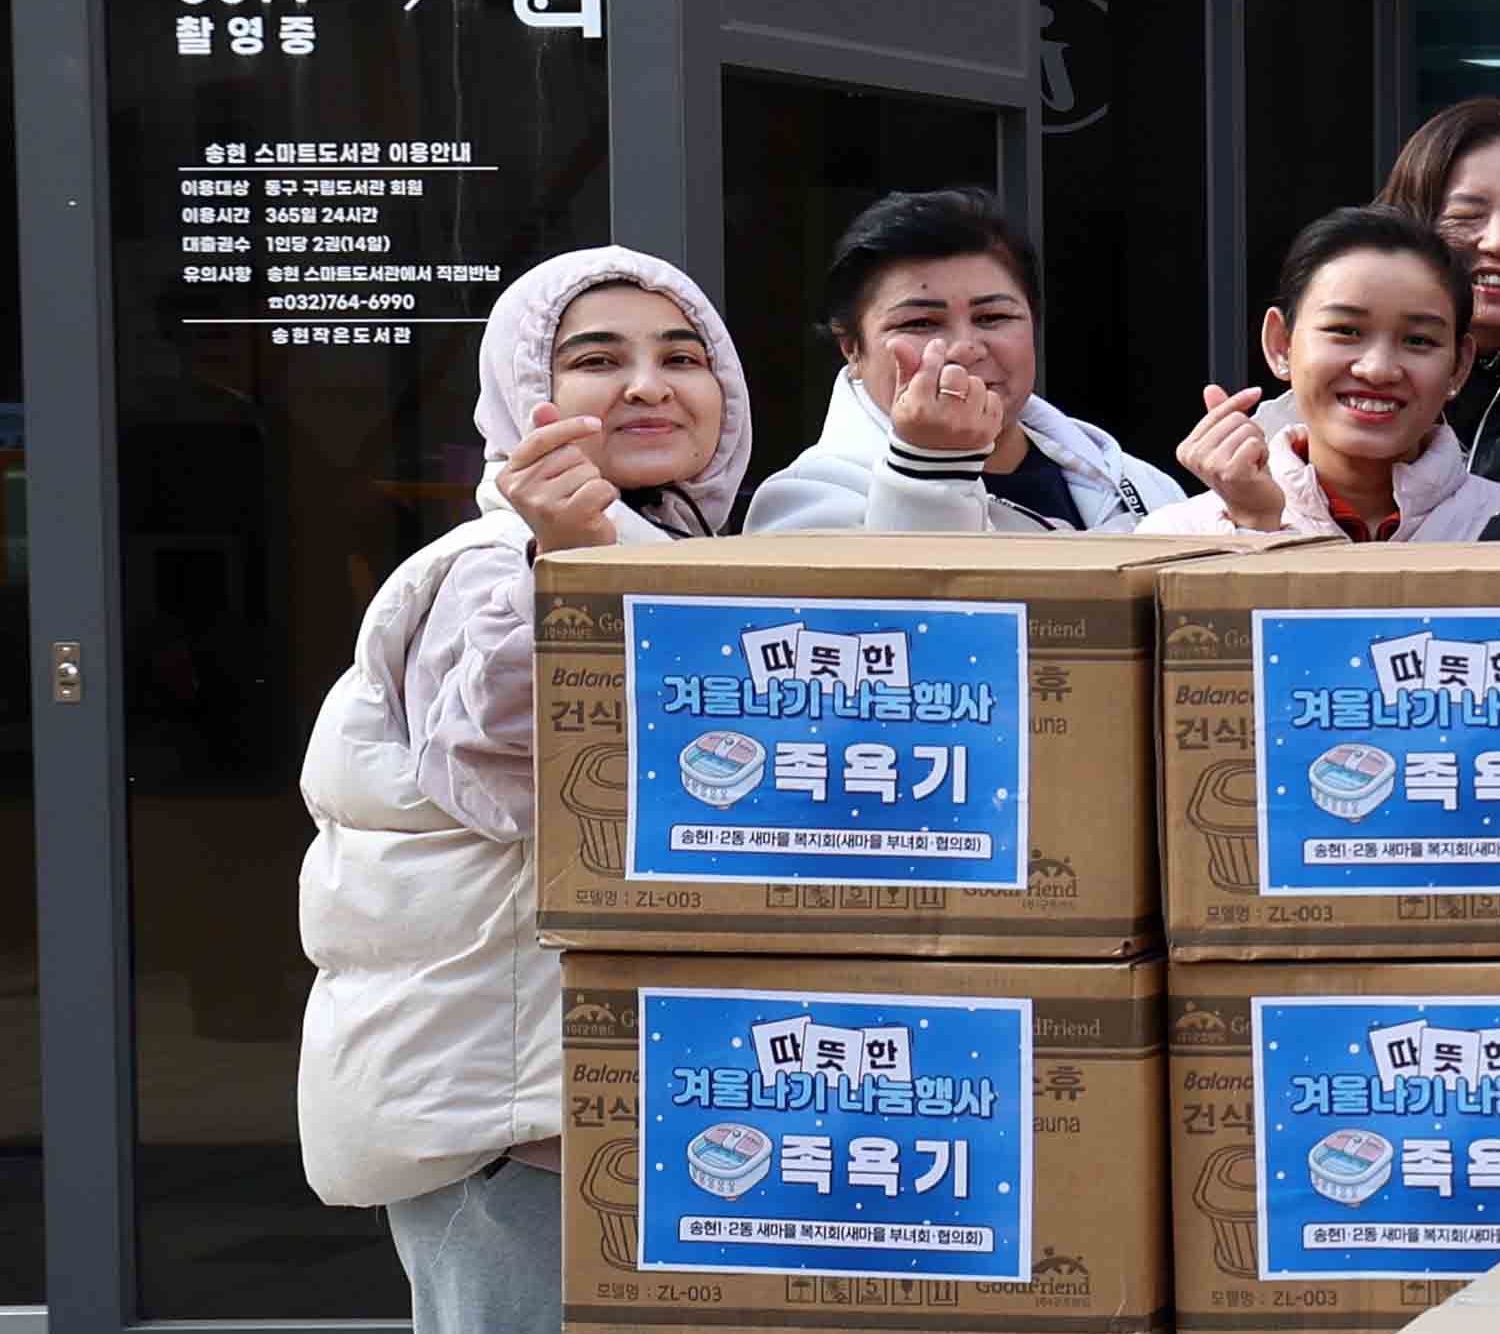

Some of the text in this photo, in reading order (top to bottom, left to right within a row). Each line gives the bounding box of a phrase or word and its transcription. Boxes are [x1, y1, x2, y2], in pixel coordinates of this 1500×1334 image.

[204, 142, 472, 165] 송현 스마트도서관 이용안내
[181, 179, 424, 197] 이용대상 동구 구립도서관 회원
[181, 207, 378, 225] 이용시간 365일 24시간
[183, 266, 252, 283] 유의사항
[266, 266, 299, 283] 송현
[303, 266, 432, 283] 스마트도서관에서
[762, 639, 896, 679] 따뜻한
[662, 675, 995, 723] 겨울나기 나눔행사
[1291, 687, 1451, 730] 겨울나기
[774, 741, 966, 804] 족욕기
[748, 831, 790, 846] 새마을
[635, 890, 703, 909] ZL-003
[769, 1033, 899, 1073] 따뜻한
[672, 1066, 995, 1118] 겨울나기 나눔행사
[1291, 1074, 1446, 1115] 겨울나기
[780, 1133, 968, 1198] 족욕기
